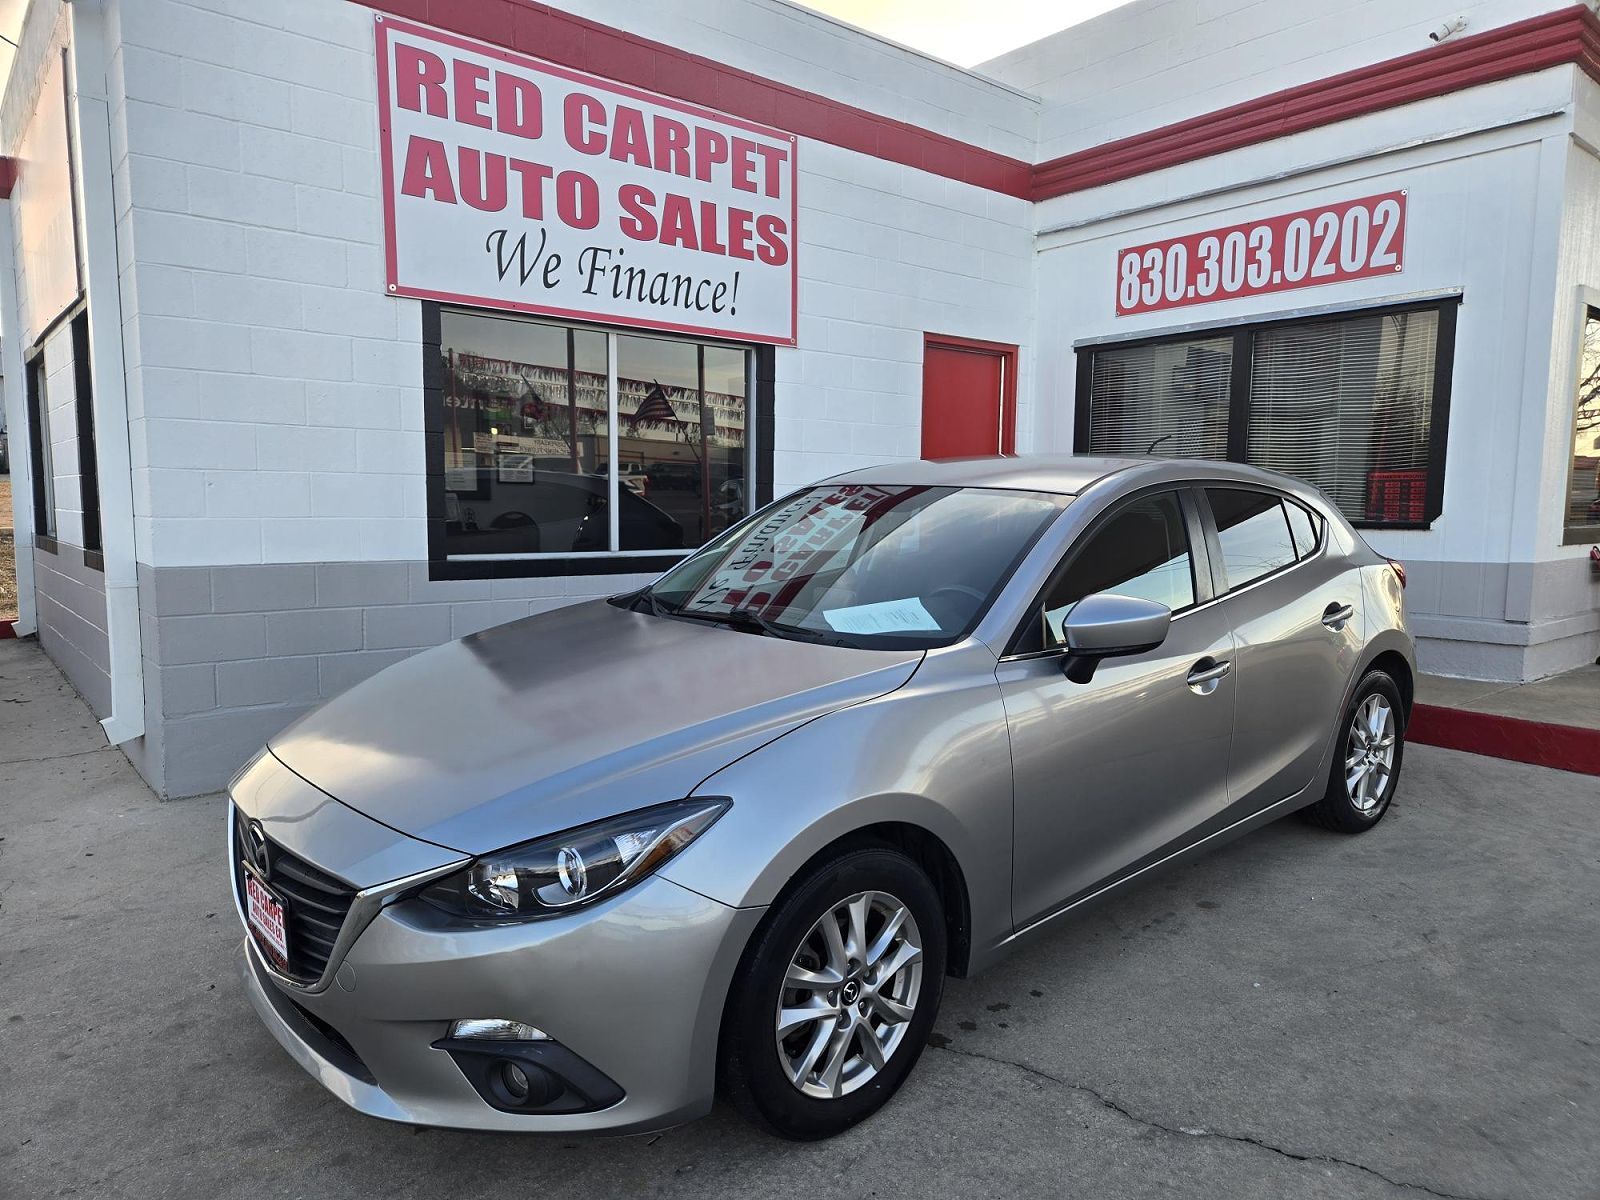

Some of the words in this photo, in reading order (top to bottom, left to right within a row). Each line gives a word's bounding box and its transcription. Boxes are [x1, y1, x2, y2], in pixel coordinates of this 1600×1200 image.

[395, 42, 543, 140] RED
[564, 92, 788, 199] CARPET
[401, 134, 600, 231] AUTO
[618, 183, 789, 267] SALES
[1119, 199, 1402, 310] 830.303.0202
[485, 227, 562, 289] We
[577, 246, 740, 316] Finance!
[260, 891, 284, 929] CARPE
